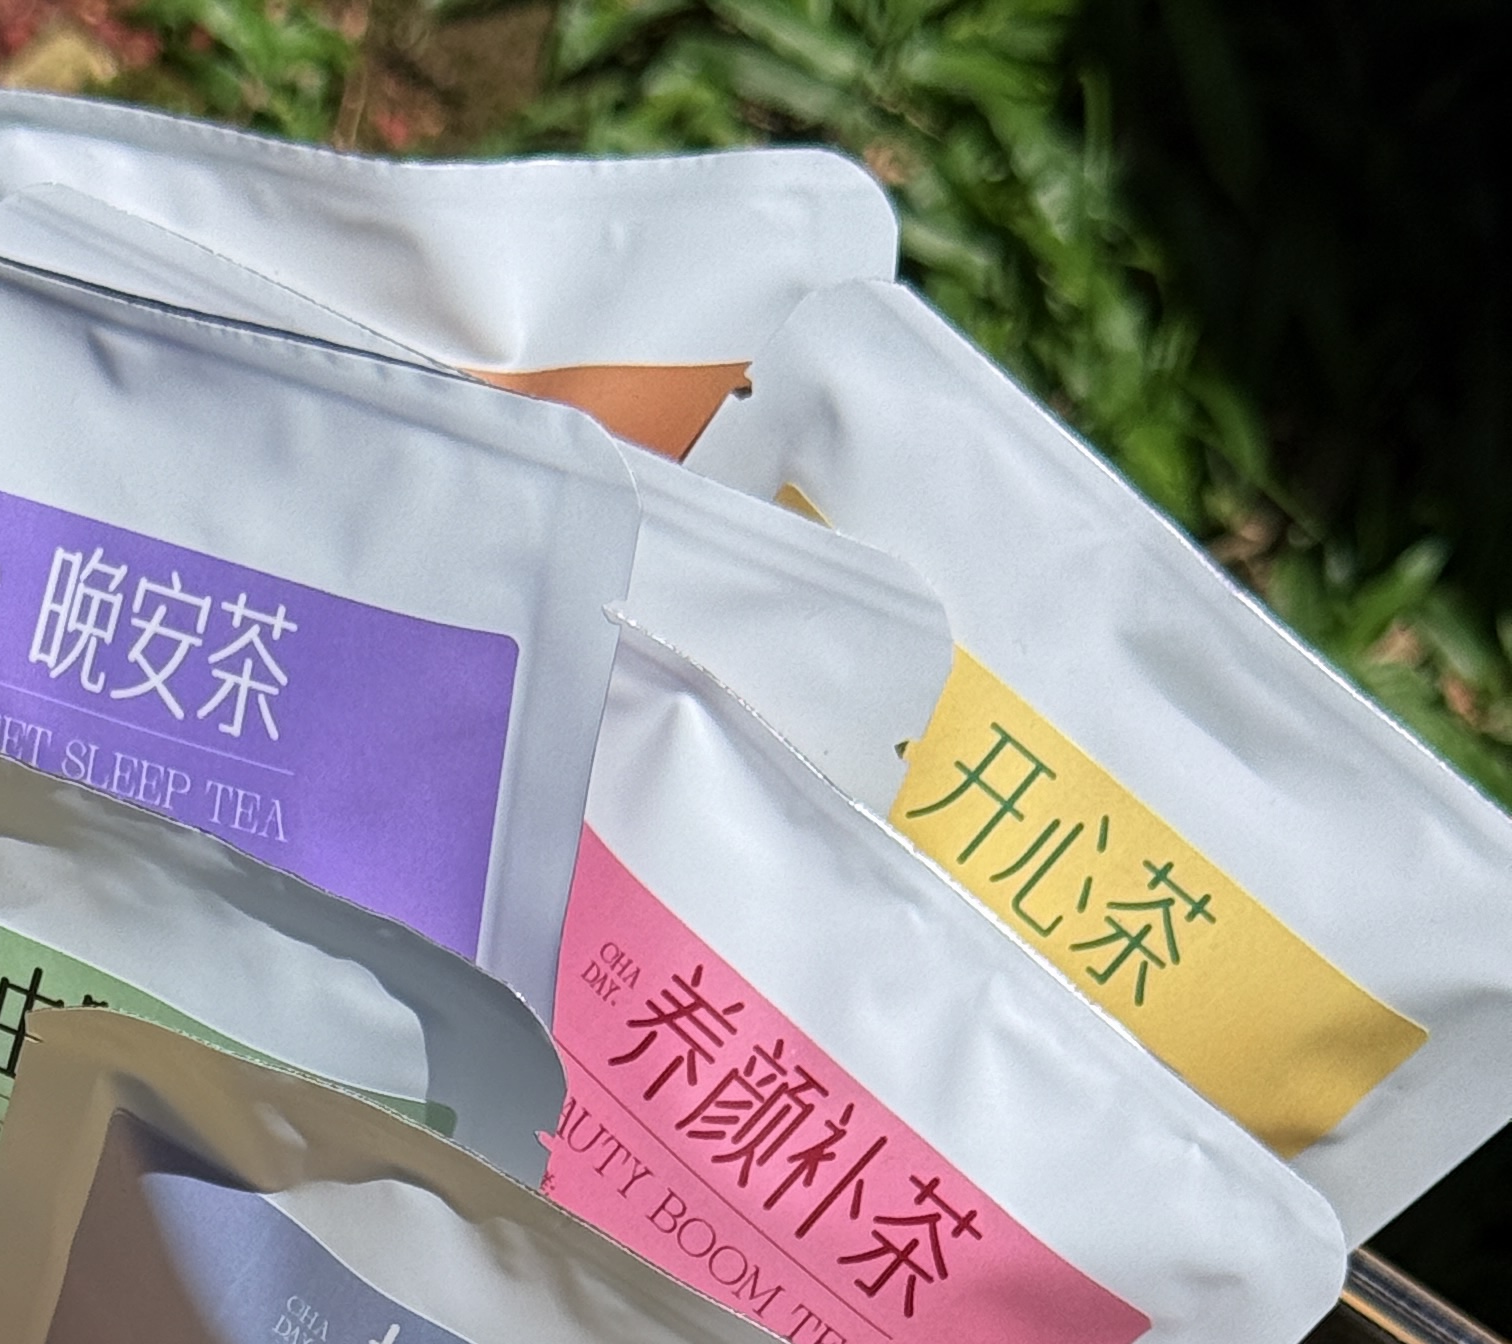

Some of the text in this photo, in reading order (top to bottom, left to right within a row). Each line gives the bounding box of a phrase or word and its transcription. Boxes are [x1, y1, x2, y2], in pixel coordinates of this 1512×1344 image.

[28, 546, 298, 742] 晚安茶
[61, 739, 191, 811] SLEEP
[206, 780, 288, 842] TEA
[906, 721, 1216, 1006] 开心茶
[581, 960, 622, 1007] DAY.
[600, 942, 642, 989] CHA
[557, 1096, 655, 1200] AUTY
[645, 1187, 786, 1319] BOOM
[608, 963, 984, 1319] 养颜补茶
[287, 1295, 329, 1342] CHA
